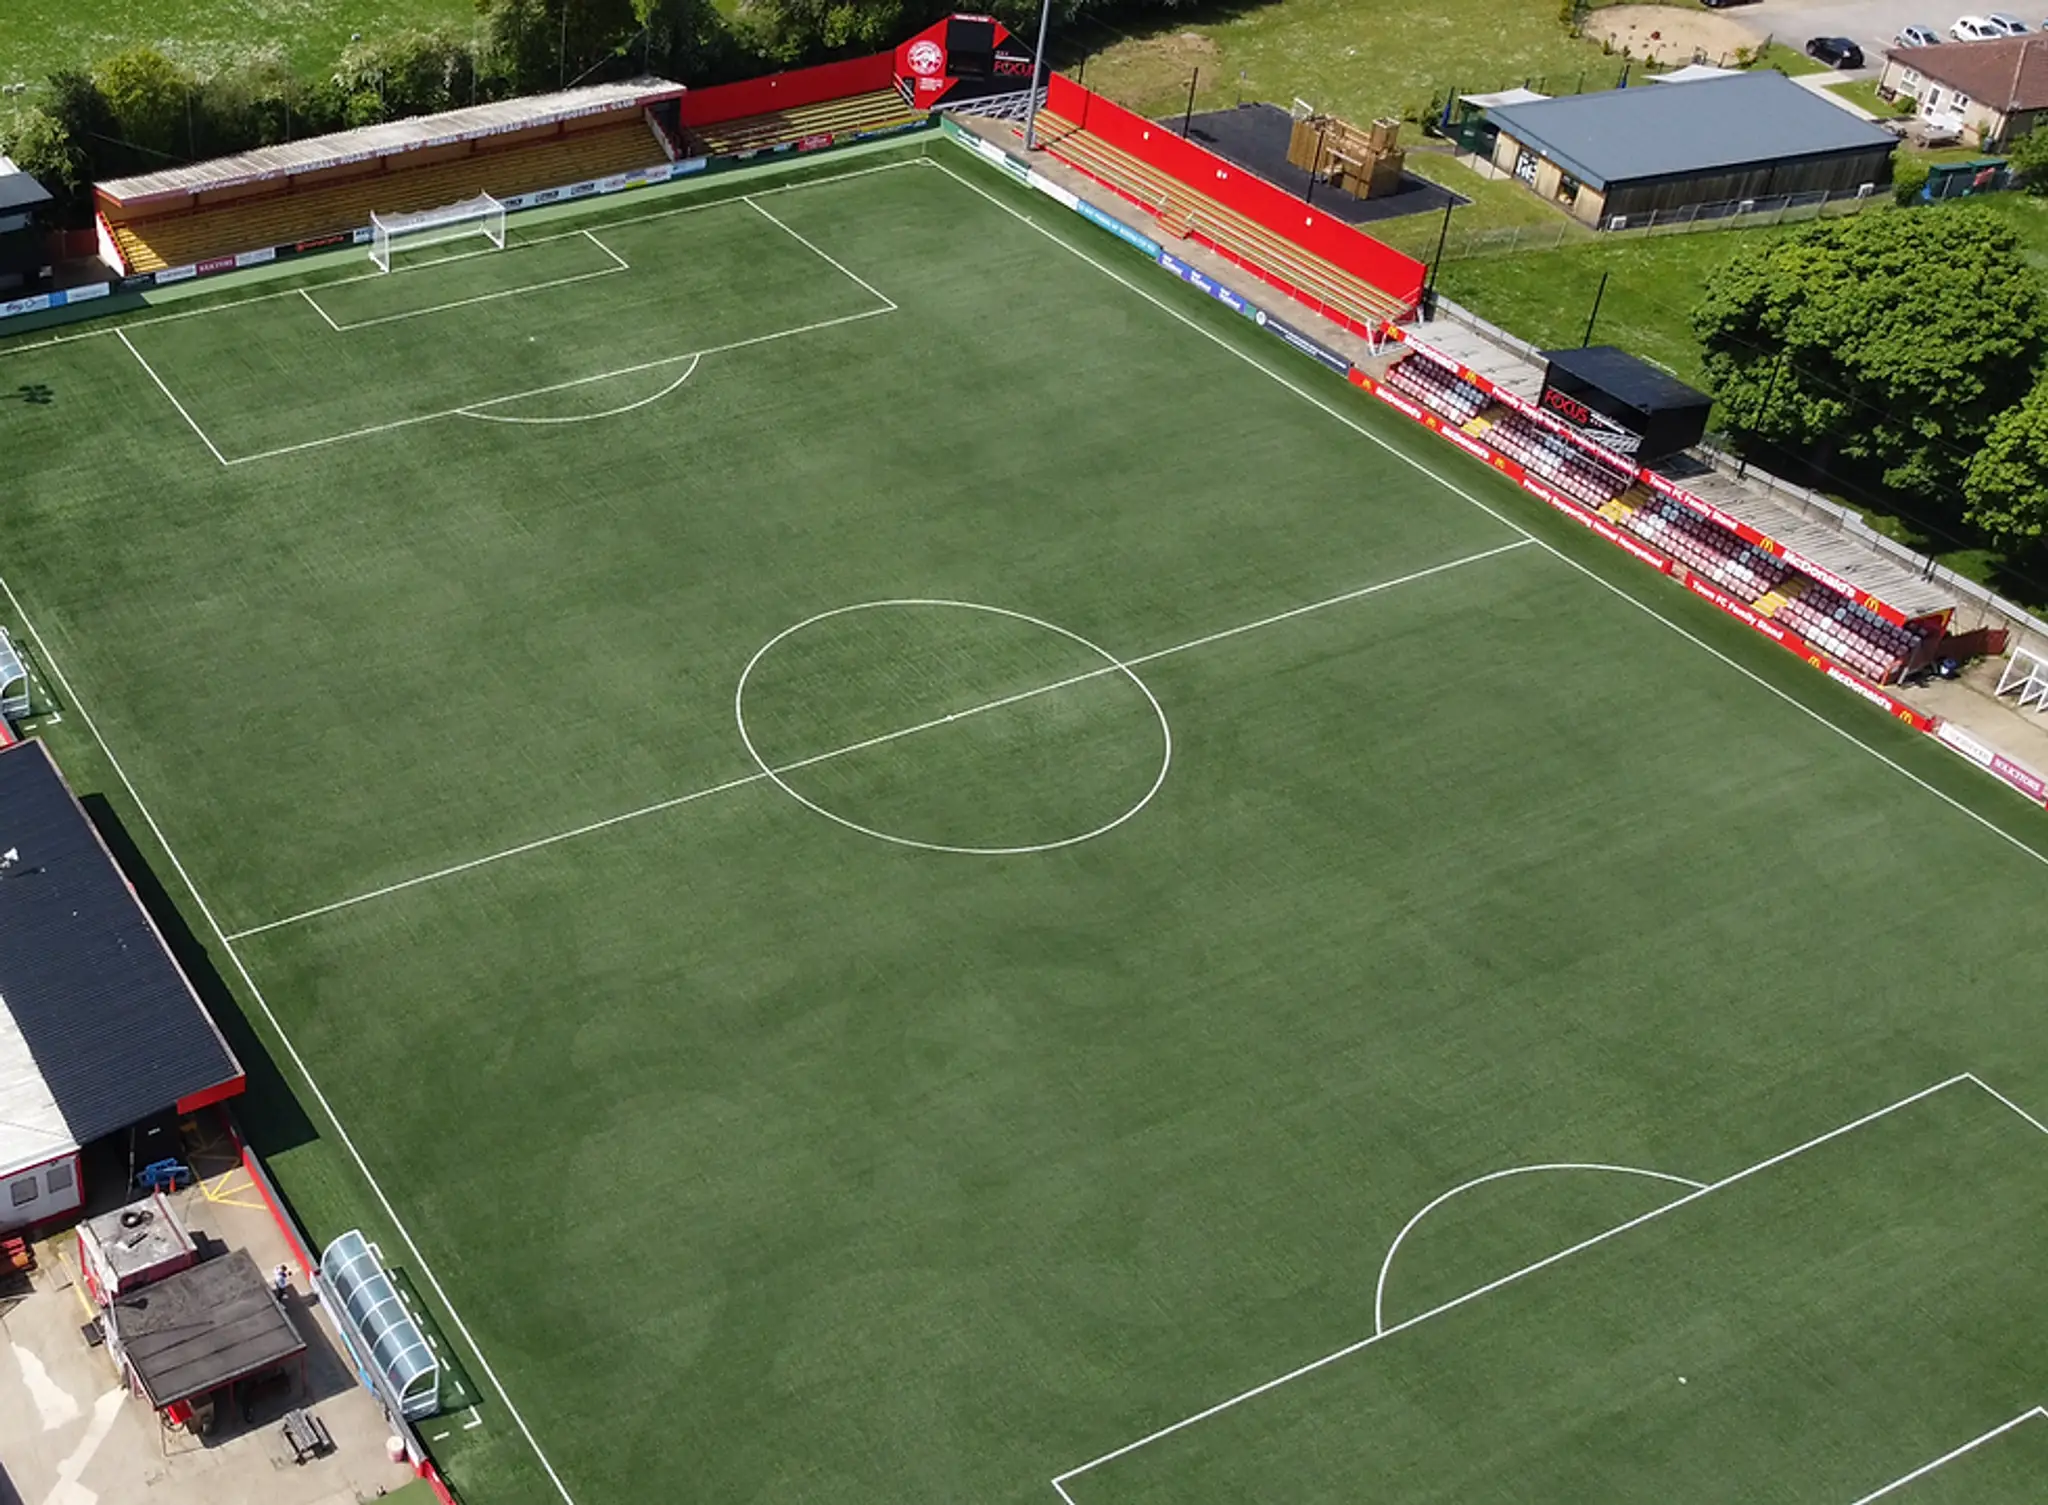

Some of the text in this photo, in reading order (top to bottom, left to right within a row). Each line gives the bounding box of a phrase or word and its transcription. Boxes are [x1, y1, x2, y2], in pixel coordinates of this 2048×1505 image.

[1375, 386, 1422, 419] McDonald's
[1544, 389, 1589, 424] FOCUS
[1441, 426, 1490, 460] McDonald's
[1523, 479, 1551, 502] Proudly
[1551, 496, 1593, 528] Supporting
[1593, 520, 1619, 541] Hemel
[1648, 475, 1672, 496] Town
[1683, 493, 1712, 518] Family
[1711, 513, 1739, 531] Stand
[1780, 549, 1856, 599] McDonald's
[1692, 580, 1785, 641] Town FC Family Stand
[1826, 667, 1893, 711] McDonald's
[1994, 758, 2041, 792] SOLICITORS
